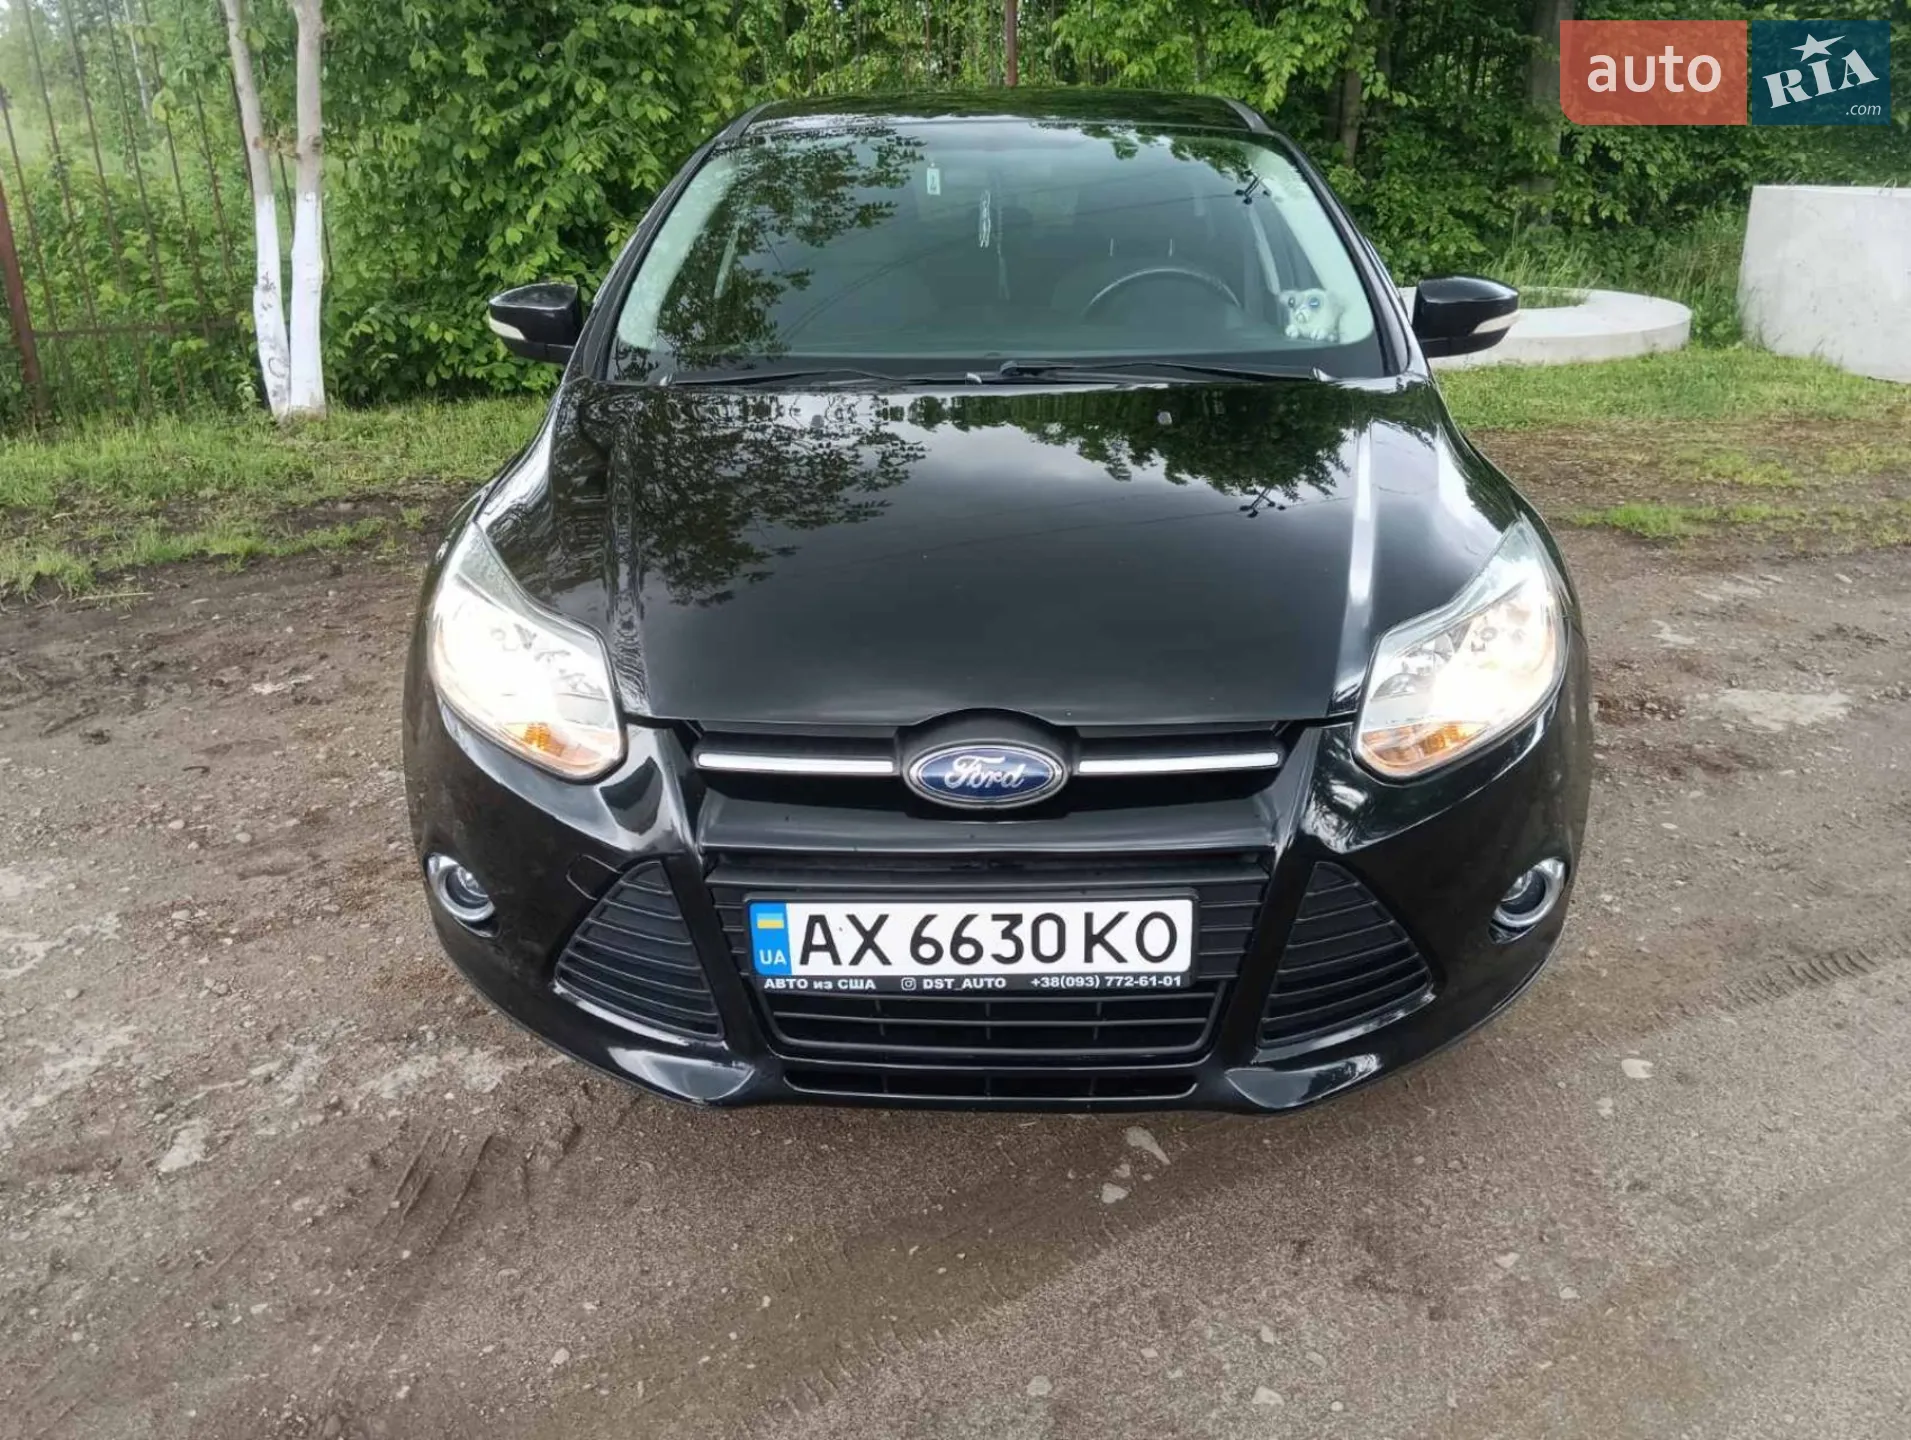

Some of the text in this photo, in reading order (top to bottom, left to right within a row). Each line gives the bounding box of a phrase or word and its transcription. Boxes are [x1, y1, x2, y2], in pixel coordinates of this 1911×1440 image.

[944, 755, 1026, 789] Ford
[799, 911, 1178, 966] AX 6630 KO
[759, 949, 787, 965] UA
[764, 978, 876, 990] АВТО из США
[1031, 975, 1182, 989] +38(093) 772-61-01
